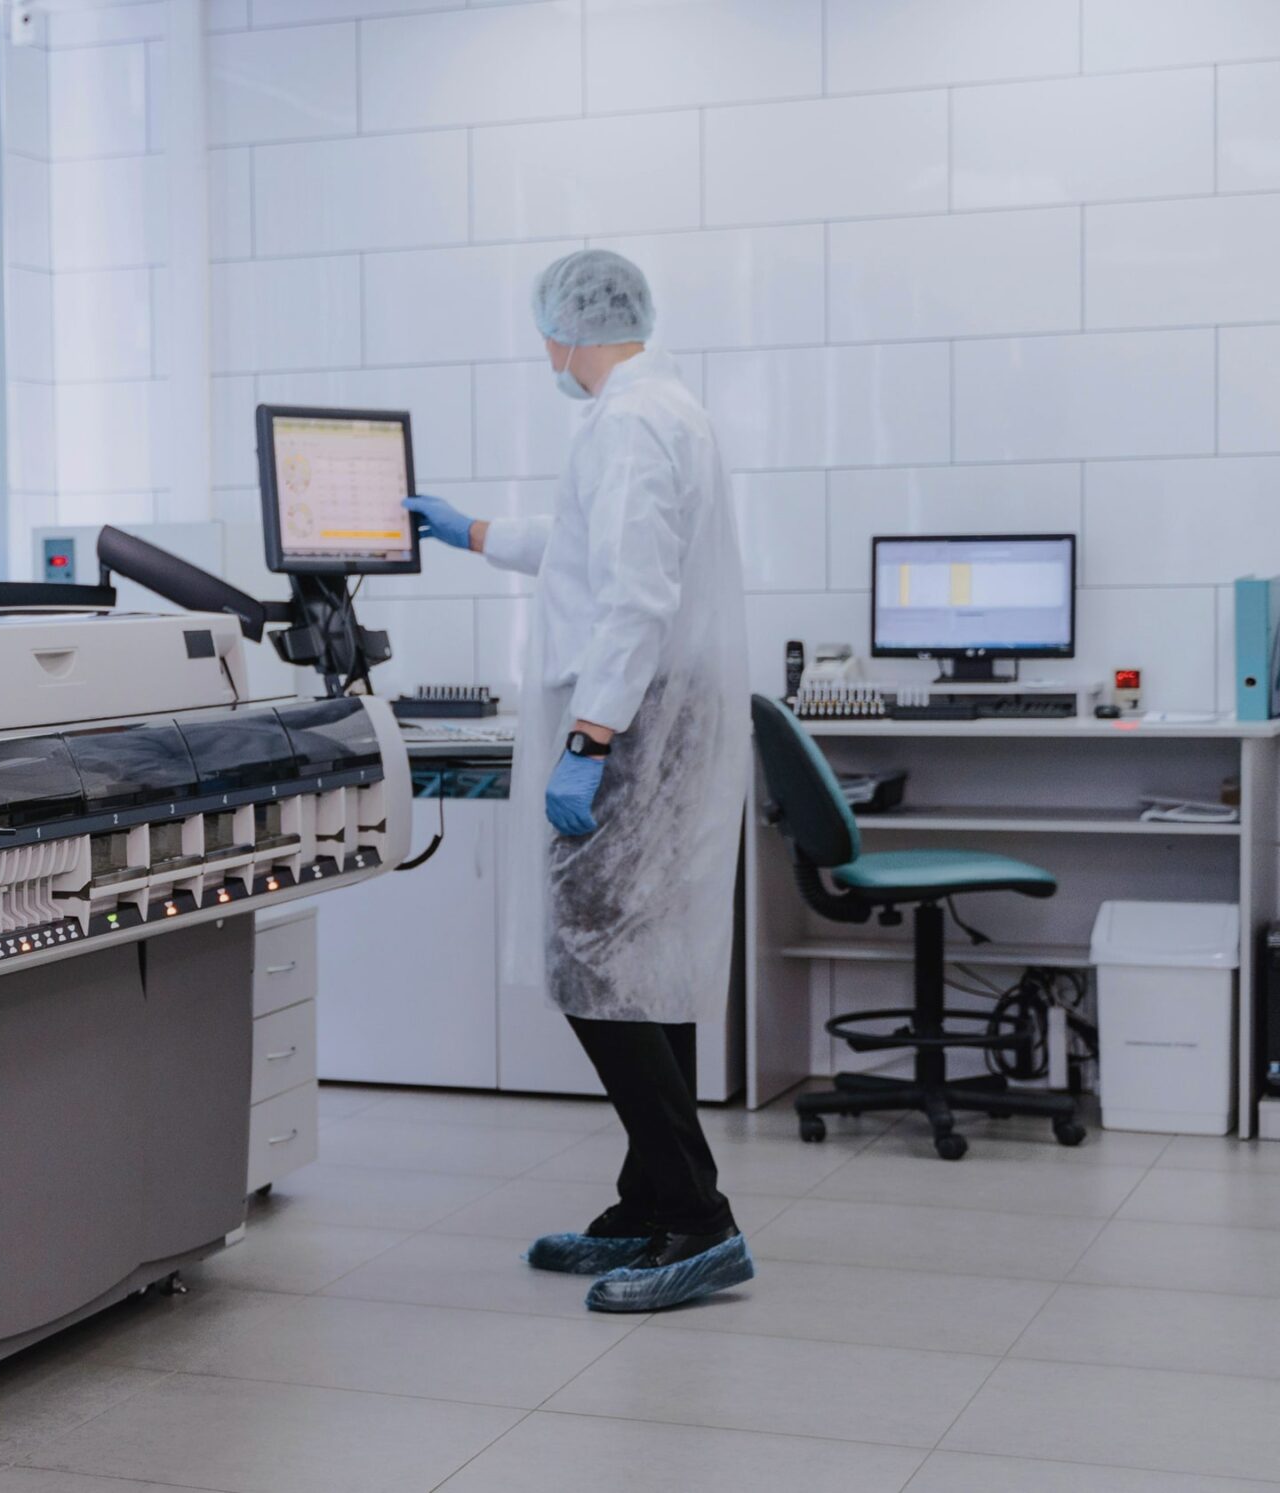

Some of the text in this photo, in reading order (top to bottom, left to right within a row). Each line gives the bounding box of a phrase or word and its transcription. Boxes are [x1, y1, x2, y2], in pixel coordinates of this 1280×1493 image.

[271, 785, 277, 796] 5
[222, 794, 228, 805] 4
[170, 803, 175, 814] 3
[113, 813, 118, 824] 2
[36, 827, 41, 838] 1
